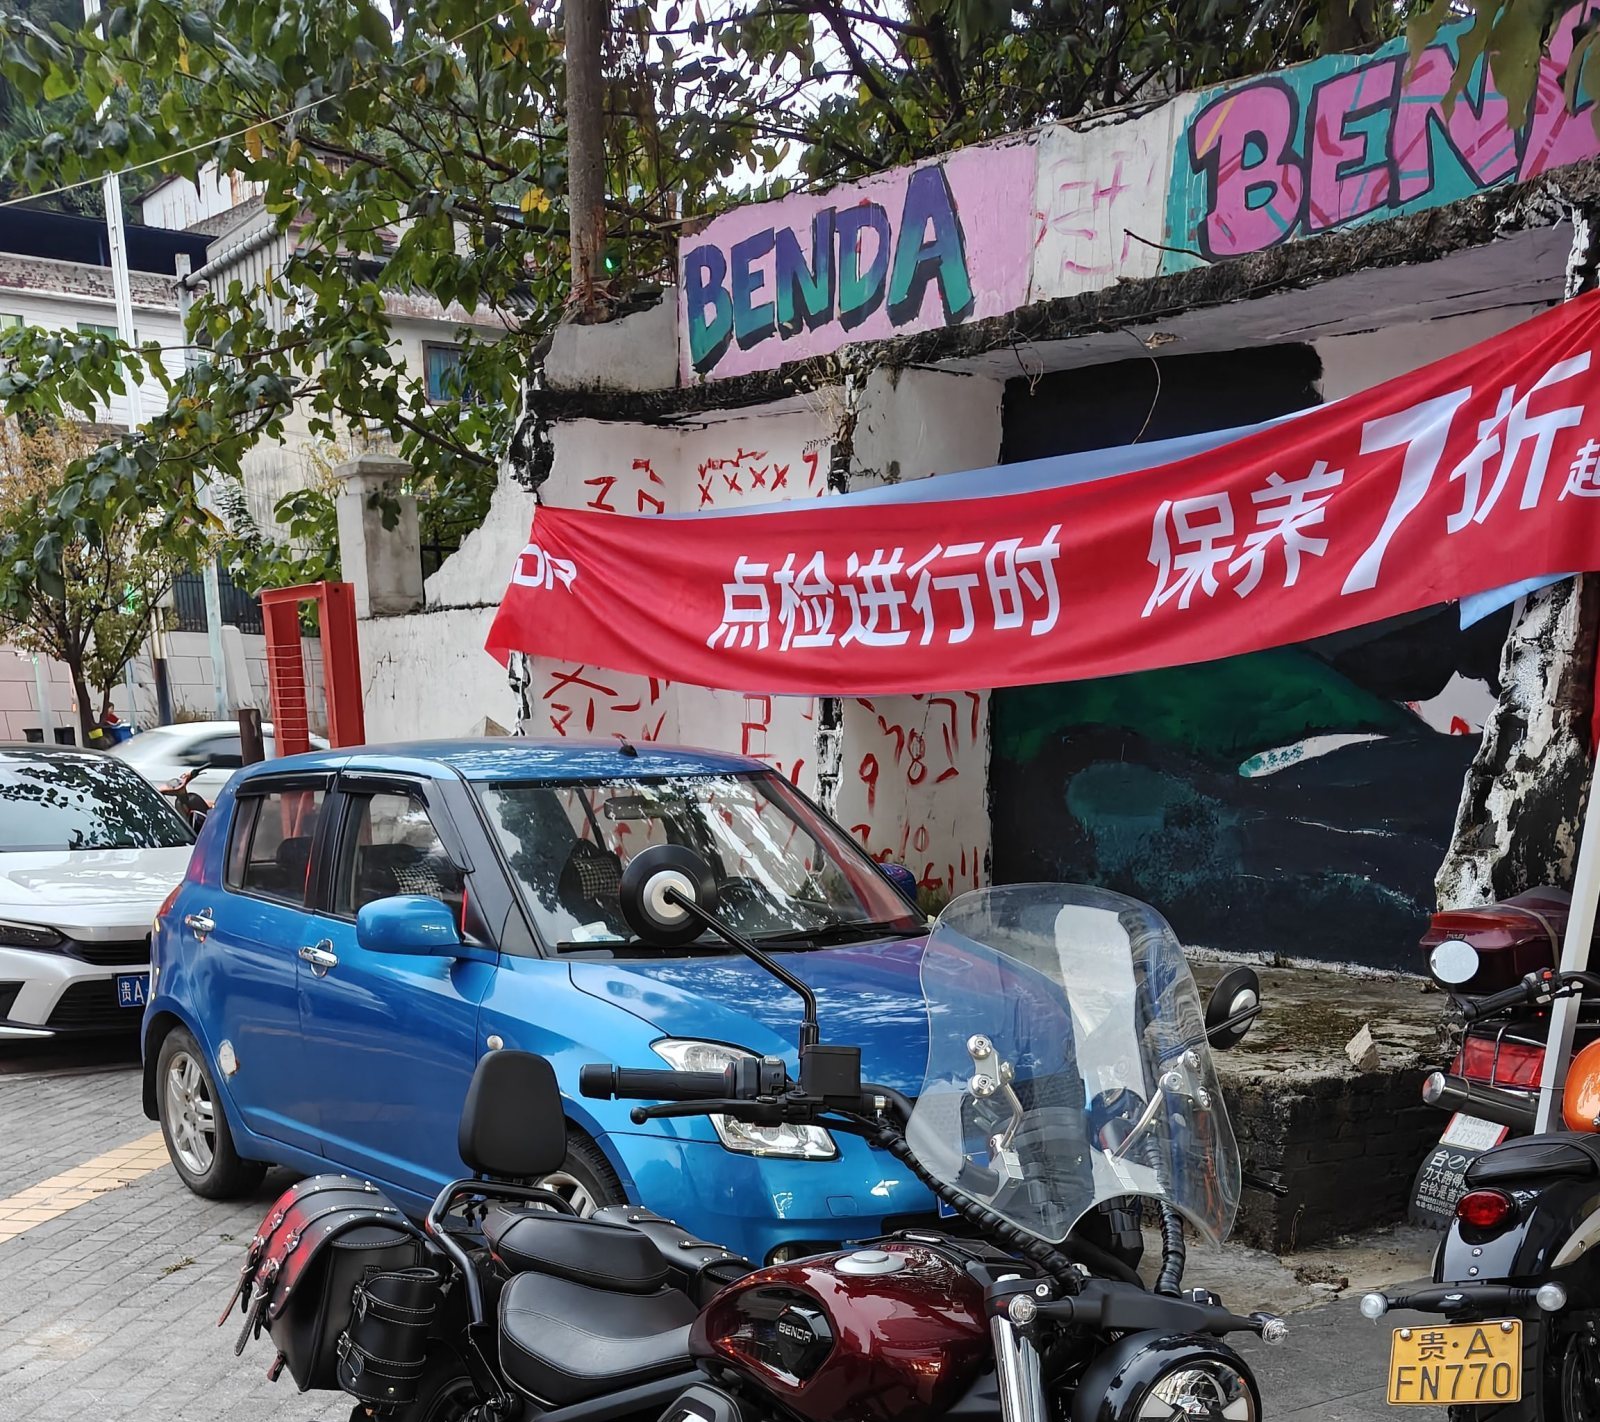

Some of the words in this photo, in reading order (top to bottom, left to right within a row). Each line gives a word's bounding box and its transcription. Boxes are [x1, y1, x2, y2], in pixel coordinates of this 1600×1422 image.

[684, 163, 975, 373] BENDA
[706, 529, 1061, 651] 点检进行时
[779, 1322, 812, 1343] BENDA
[1395, 1362, 1512, 1401] FN770
